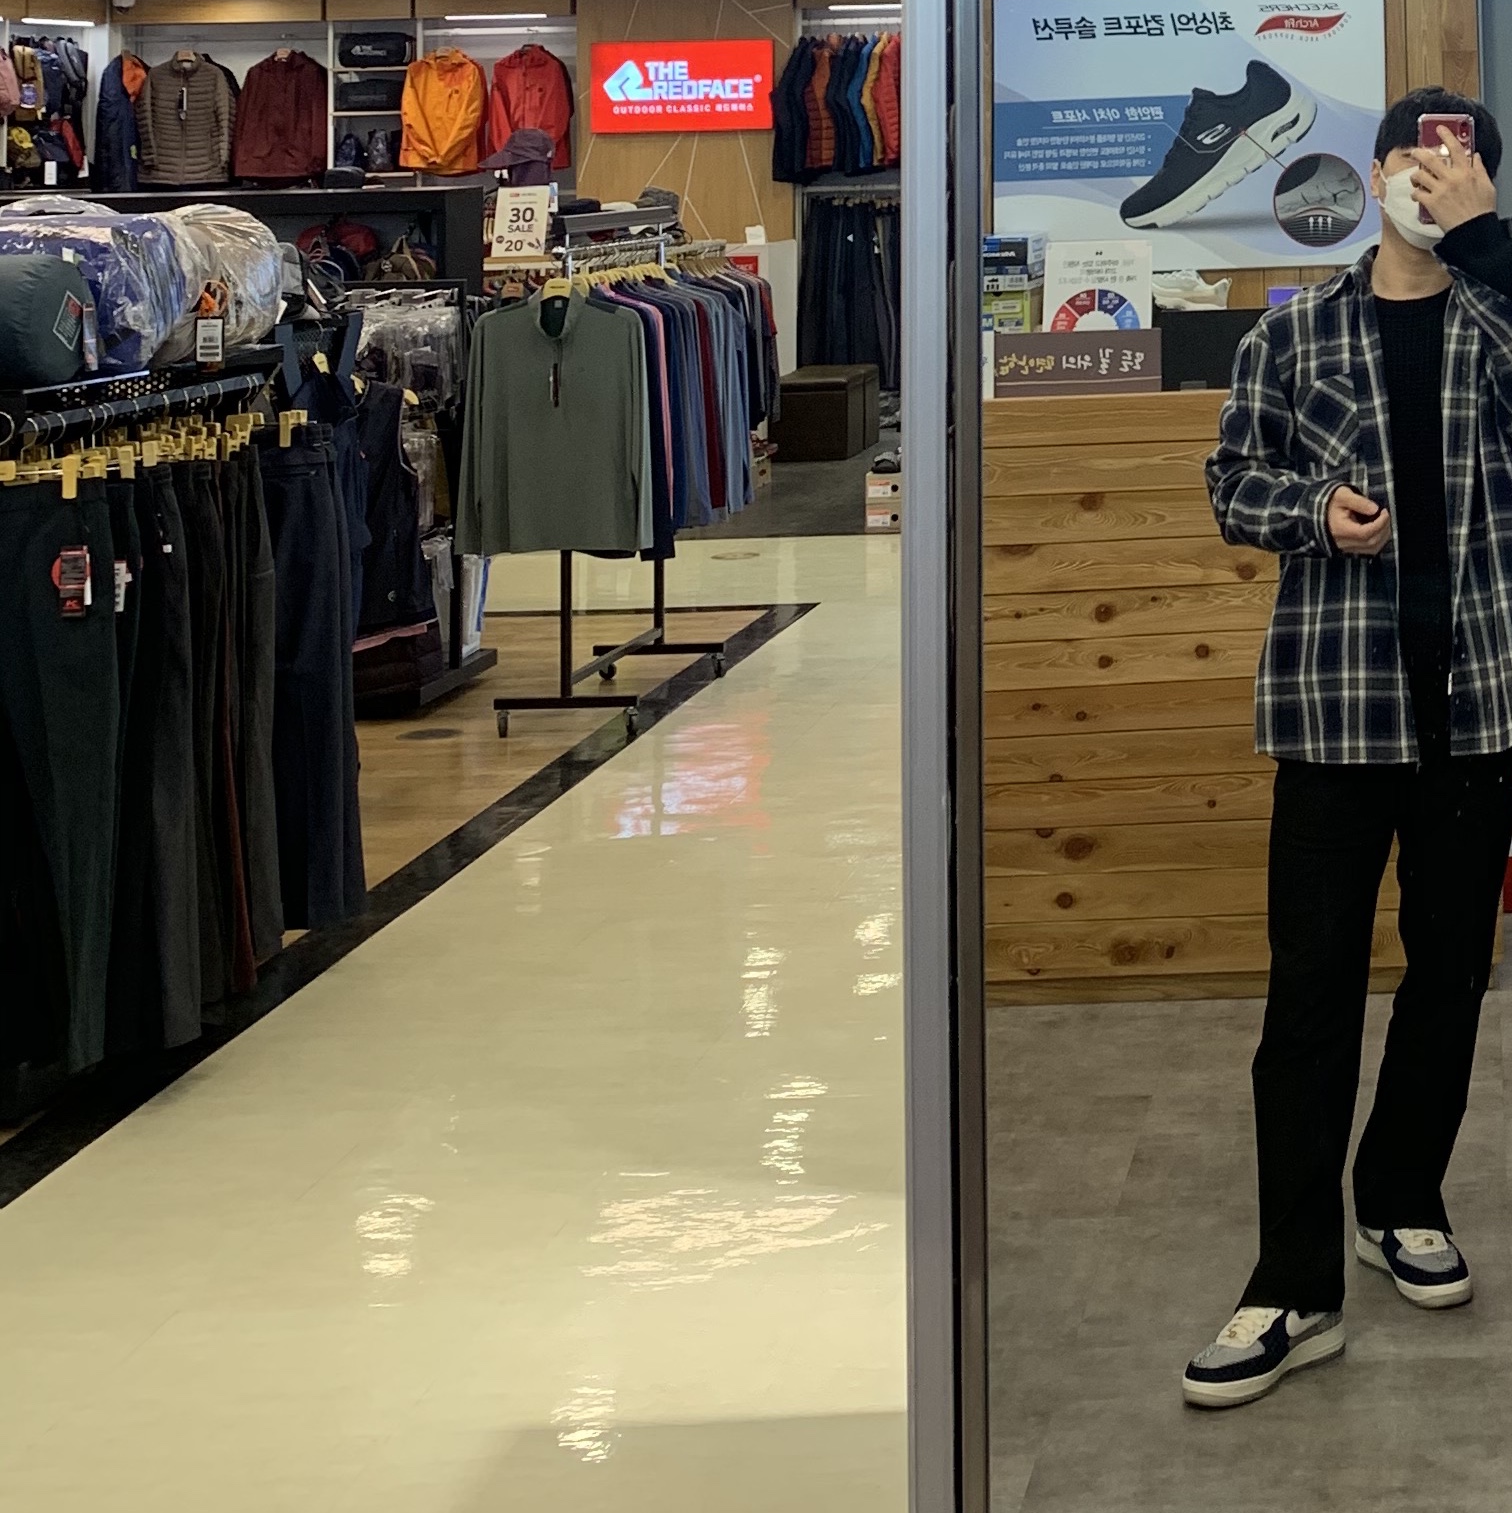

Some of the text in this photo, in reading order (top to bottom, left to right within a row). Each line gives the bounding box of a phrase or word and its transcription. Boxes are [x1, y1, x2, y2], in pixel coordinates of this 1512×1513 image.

[645, 60, 689, 81] THE
[653, 78, 755, 101] REDFACE
[612, 104, 663, 115] OUTDOOR
[666, 103, 711, 114] CLASSIC
[507, 223, 535, 233] SALE
